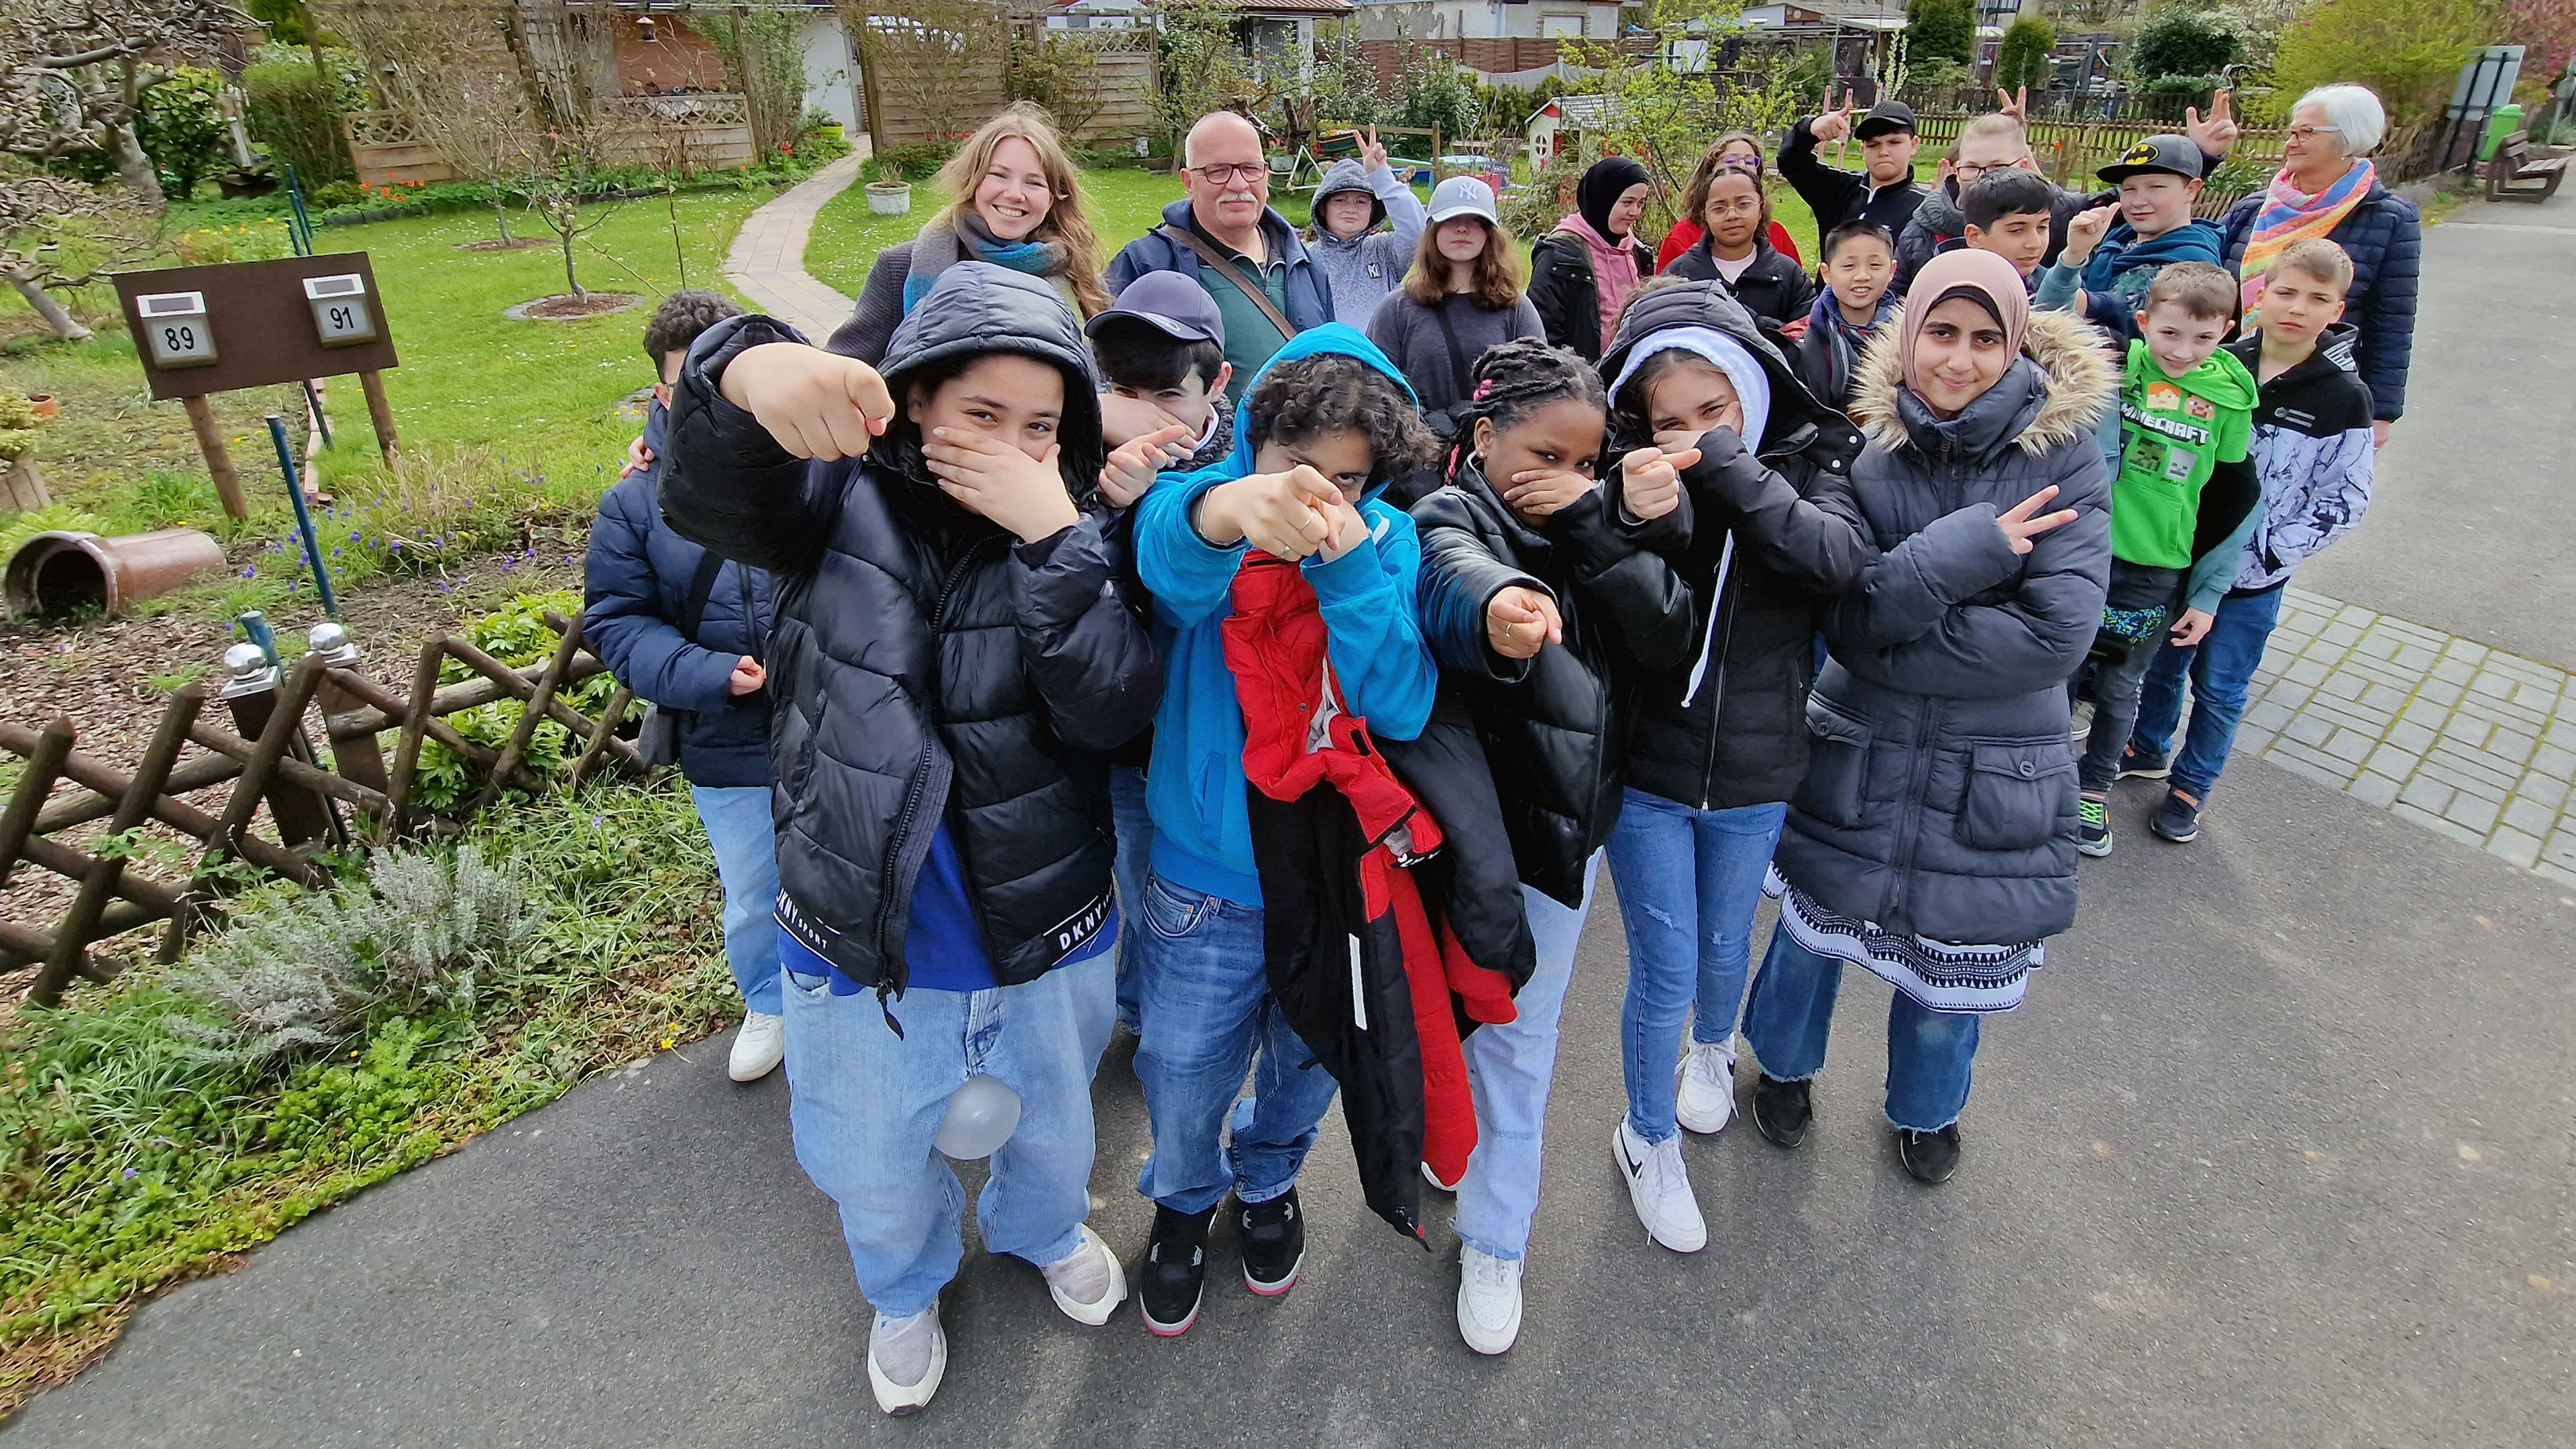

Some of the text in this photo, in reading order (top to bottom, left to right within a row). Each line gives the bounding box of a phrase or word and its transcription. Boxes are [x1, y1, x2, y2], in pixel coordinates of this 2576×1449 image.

[1459, 182, 1477, 200] NY
[330, 306, 355, 330] 91
[165, 326, 195, 352] 89
[2120, 402, 2209, 444] MINECRAFT
[798, 918, 827, 949] SPORT
[1059, 903, 1101, 950] DKNY
